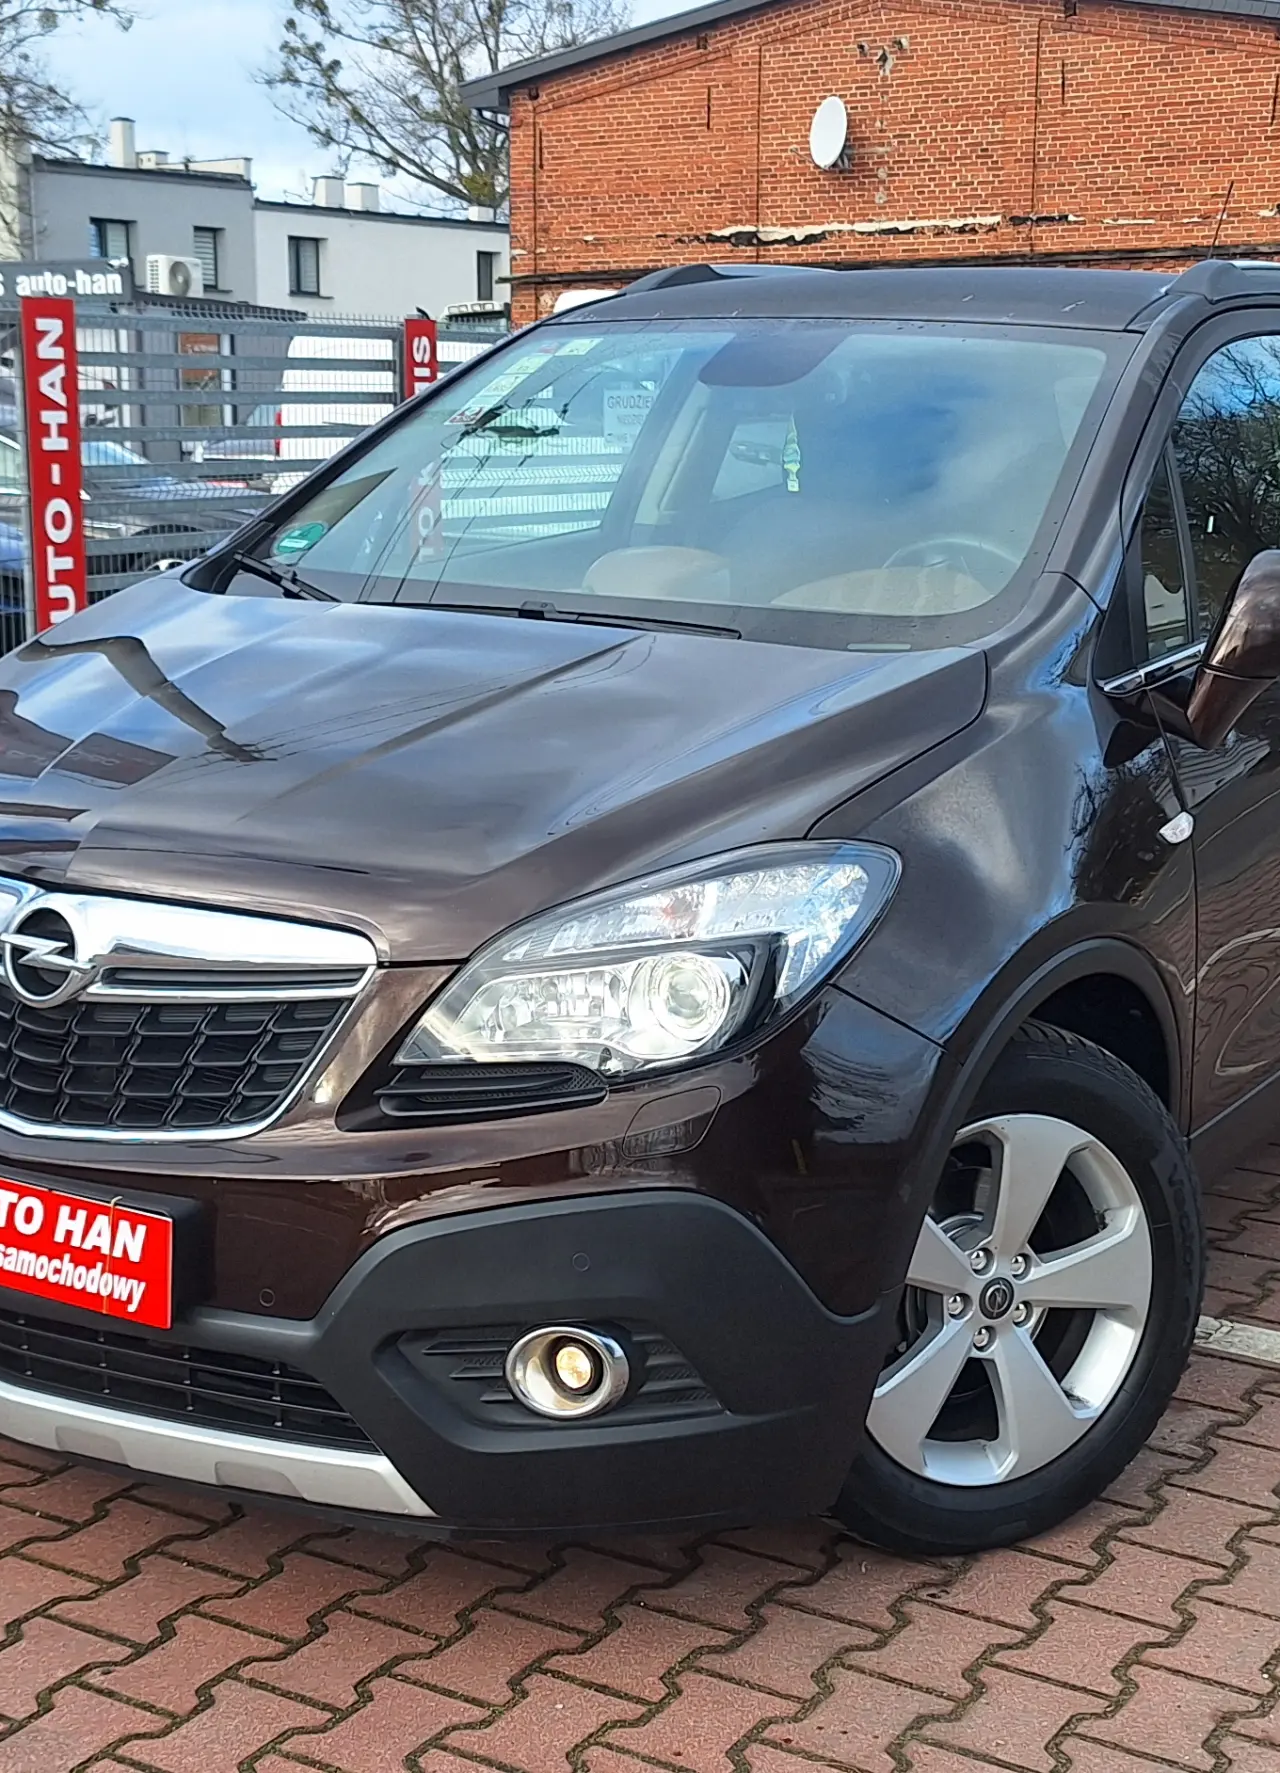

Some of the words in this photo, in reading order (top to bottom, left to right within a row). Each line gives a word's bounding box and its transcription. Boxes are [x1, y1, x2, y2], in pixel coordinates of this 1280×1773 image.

[16, 270, 123, 297] auto-han
[34, 316, 77, 626] UTO-HAN
[53, 1204, 148, 1263] HAN
